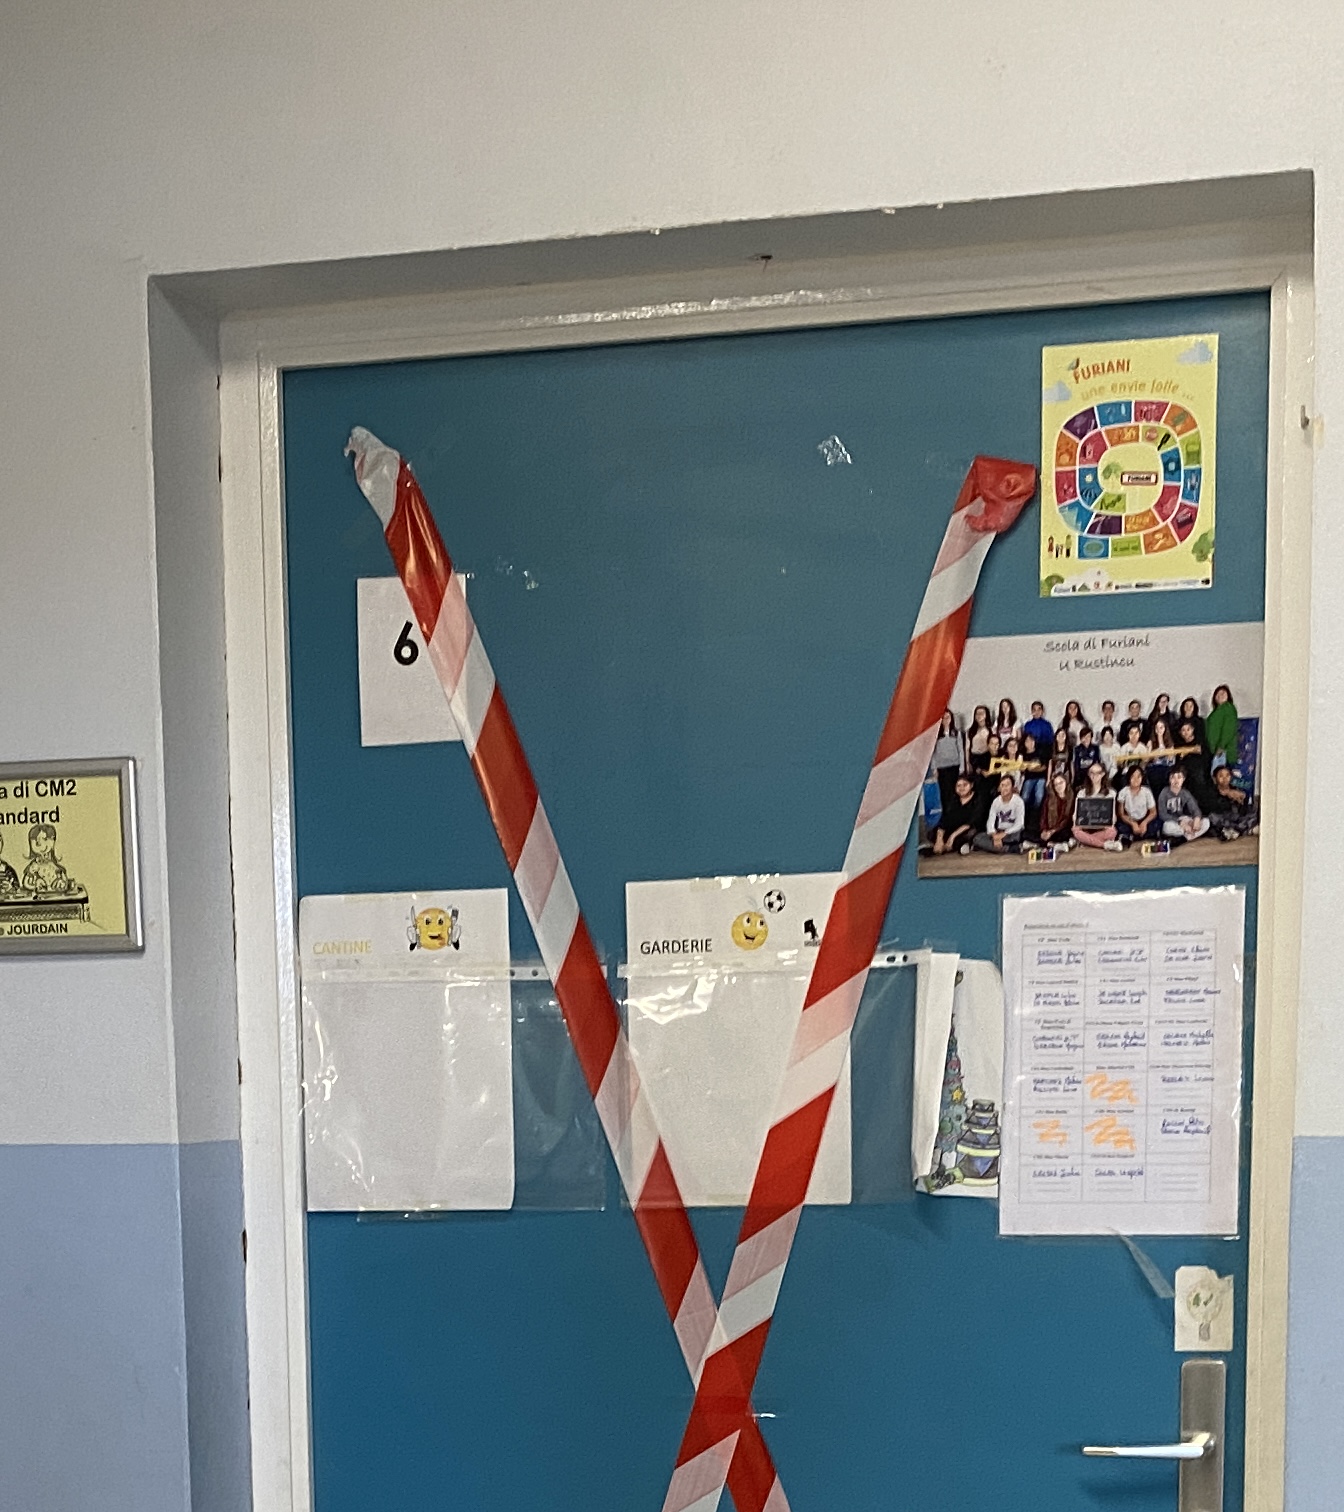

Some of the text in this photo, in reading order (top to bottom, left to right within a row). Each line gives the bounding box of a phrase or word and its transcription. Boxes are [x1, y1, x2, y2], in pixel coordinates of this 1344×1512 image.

[1072, 358, 1131, 384] FURIANI
[1110, 380, 1146, 394] envie
[394, 620, 418, 666] 6
[1043, 633, 1151, 653] Scola di Furiani
[13, 781, 29, 798] di
[35, 779, 77, 797] CM2
[7, 923, 68, 935] JOURDAIN
[312, 940, 372, 955] CANTINE
[640, 938, 713, 955] GARDERIE
